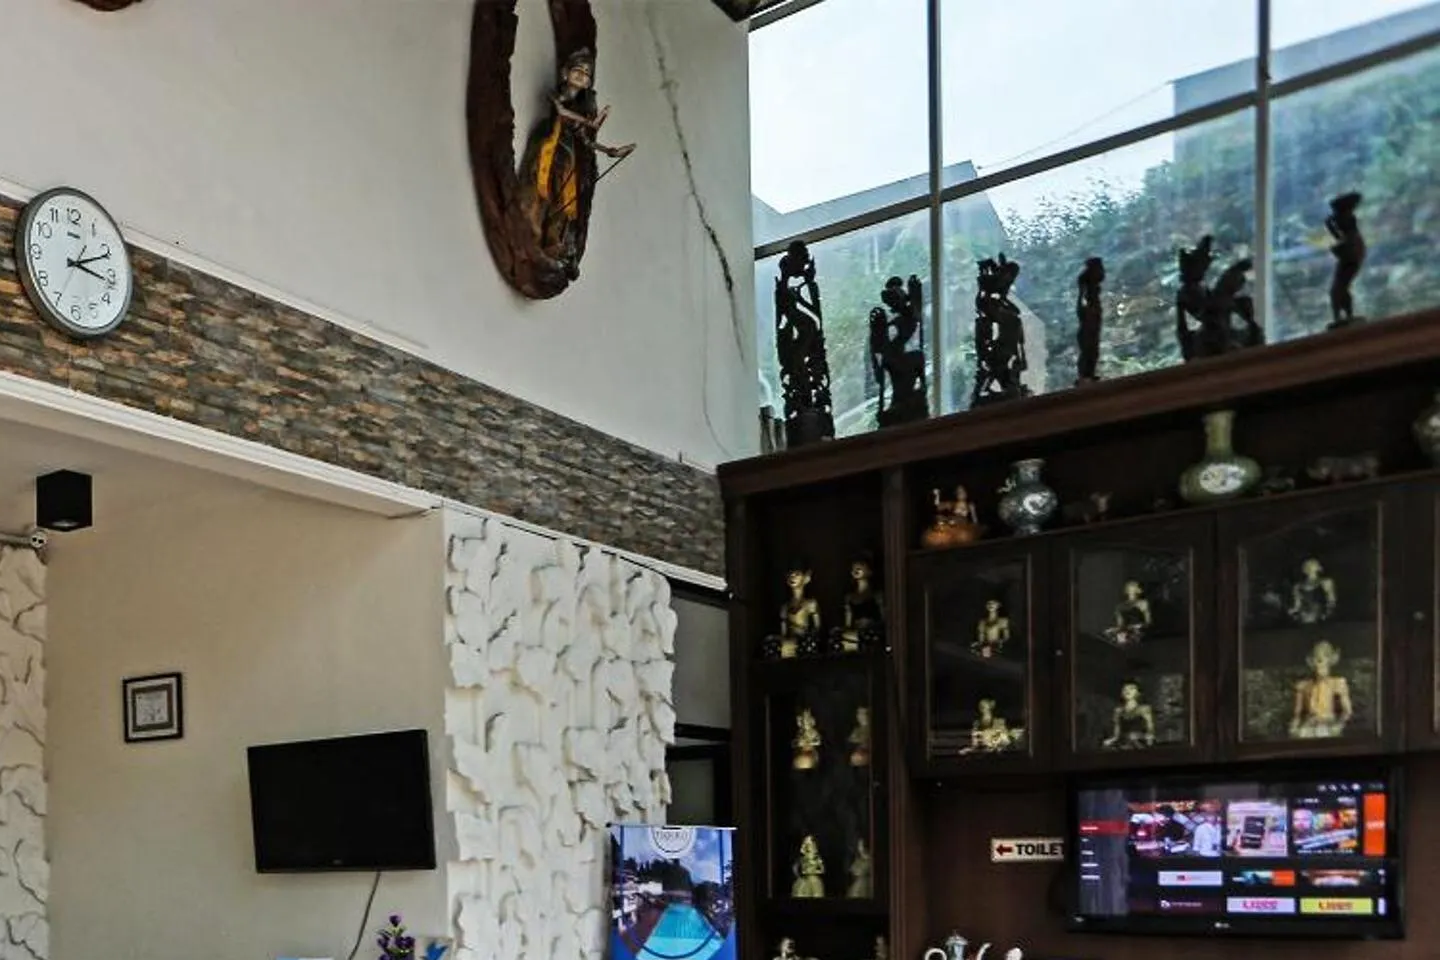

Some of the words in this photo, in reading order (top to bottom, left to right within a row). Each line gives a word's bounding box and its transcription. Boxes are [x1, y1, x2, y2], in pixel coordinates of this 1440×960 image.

[49, 207, 58, 223] 11
[67, 207, 81, 225] 12
[36, 222, 52, 238] 10
[31, 243, 41, 260] 9
[38, 270, 48, 286] 8
[53, 291, 62, 306] 7
[101, 292, 111, 305] 4
[71, 305, 81, 321] 6
[88, 302, 98, 319] 5
